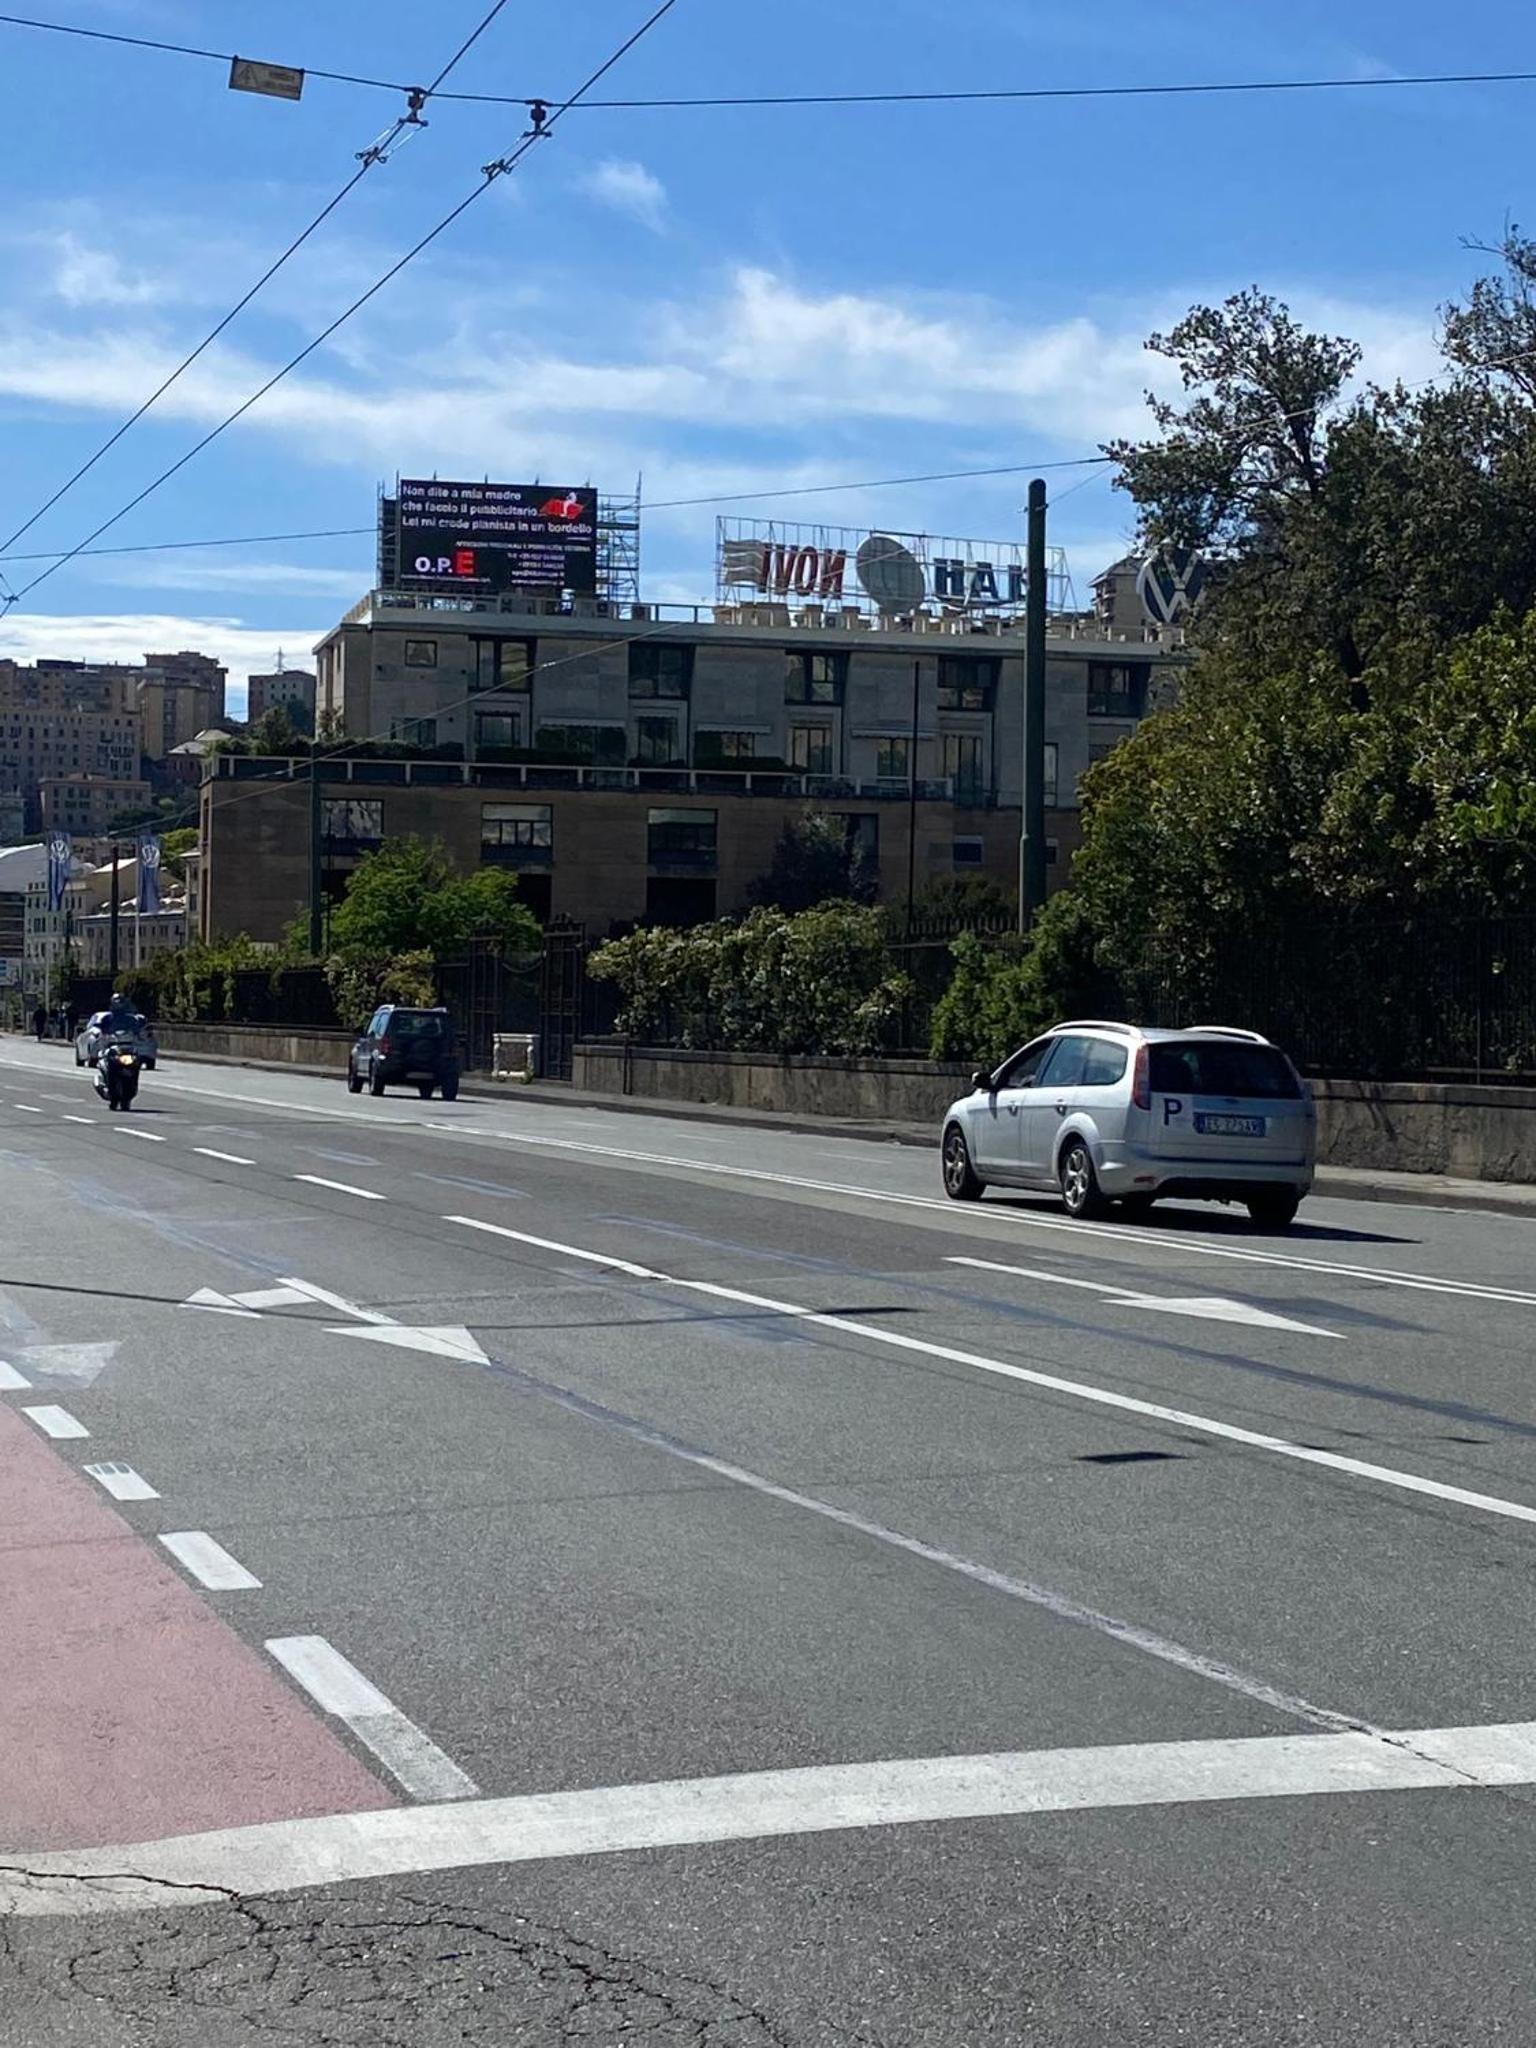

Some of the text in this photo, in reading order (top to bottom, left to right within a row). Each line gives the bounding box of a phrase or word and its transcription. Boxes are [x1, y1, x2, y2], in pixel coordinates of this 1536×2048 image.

[402, 485, 425, 497] Non
[451, 489, 459, 498] a
[402, 501, 423, 512] che
[1164, 1098, 1182, 1126] P
